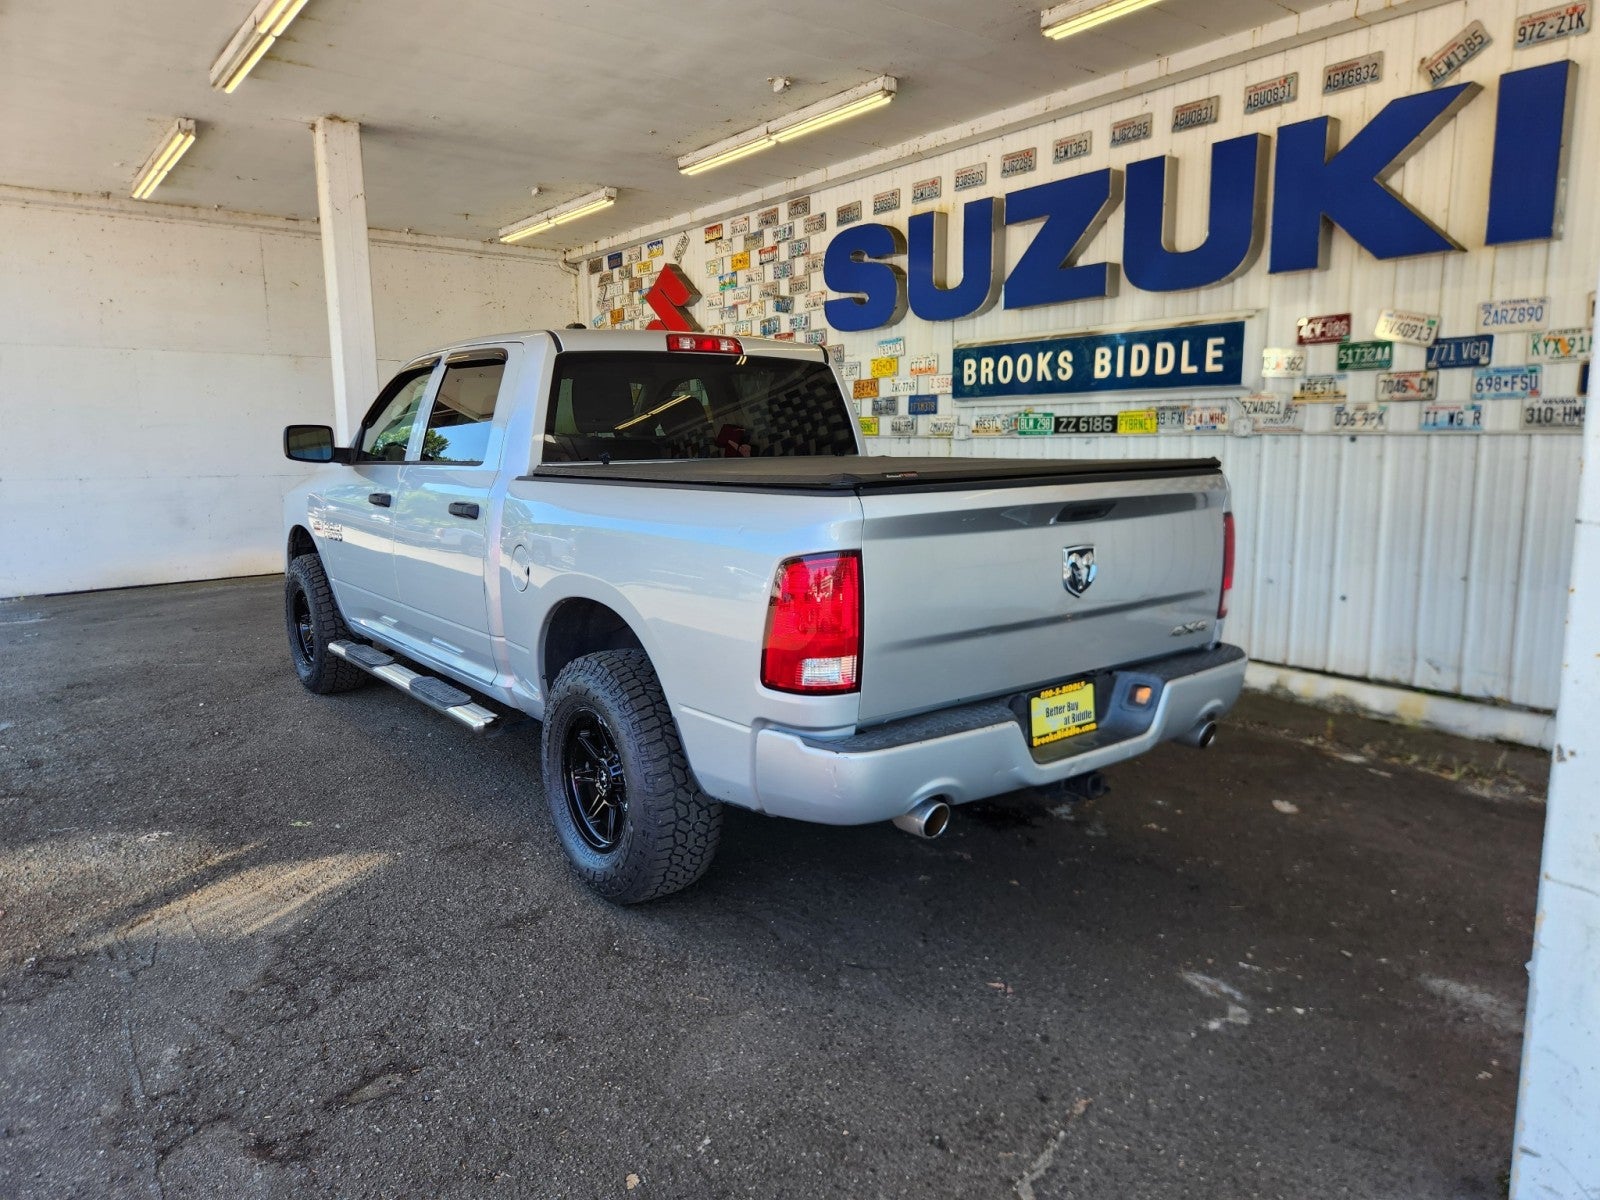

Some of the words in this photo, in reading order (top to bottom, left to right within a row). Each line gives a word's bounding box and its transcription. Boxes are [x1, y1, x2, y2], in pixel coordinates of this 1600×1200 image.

[1428, 29, 1484, 81] AEW1385
[1325, 62, 1378, 90] AGY6832
[824, 60, 1574, 331] SUZUKI
[1482, 305, 1544, 326] 2ARZ890
[963, 350, 1074, 386] BROOKS
[1093, 337, 1226, 379] BIDDLE
[1045, 704, 1066, 718] Better
[1067, 701, 1079, 712] Buy
[1063, 716, 1071, 726] at
[1071, 710, 1092, 724] Biddle
